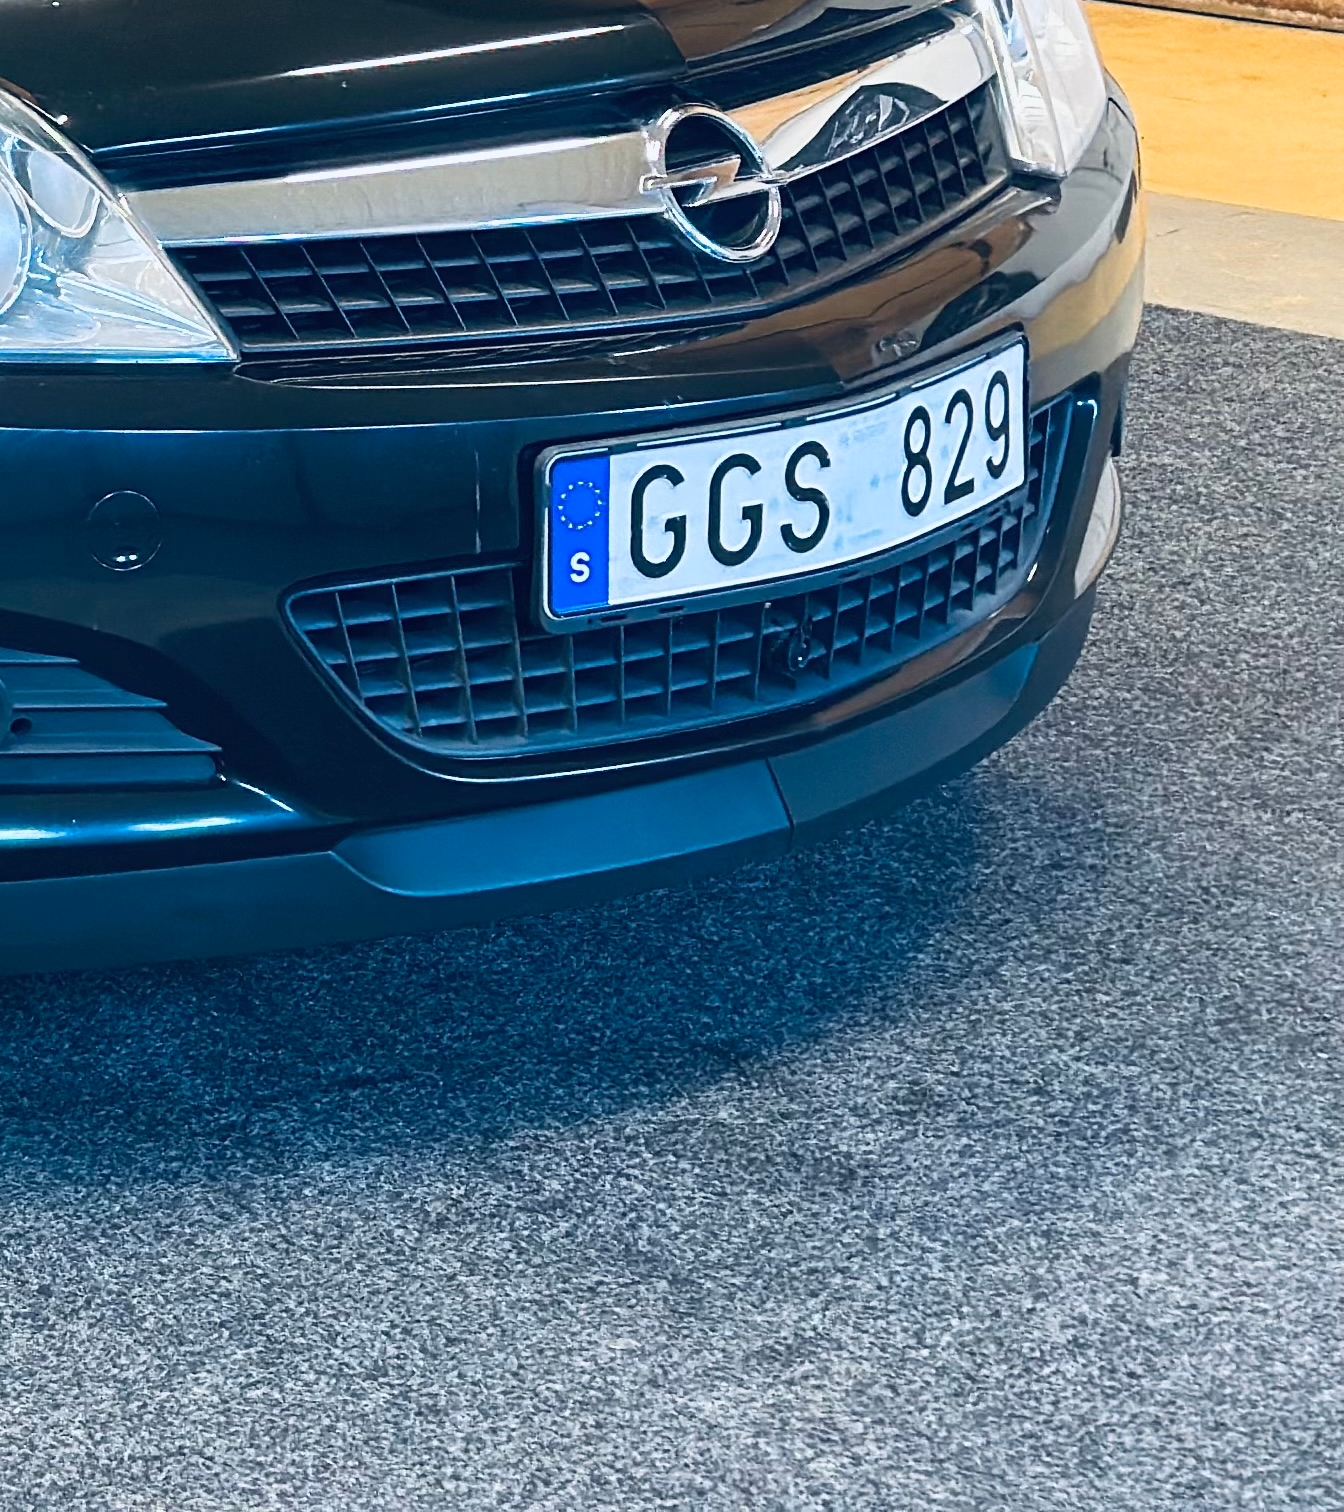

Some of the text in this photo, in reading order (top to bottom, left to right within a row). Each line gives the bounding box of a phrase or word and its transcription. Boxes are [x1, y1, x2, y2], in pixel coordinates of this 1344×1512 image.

[629, 370, 1010, 579] GGS 829
[569, 551, 591, 584] S
